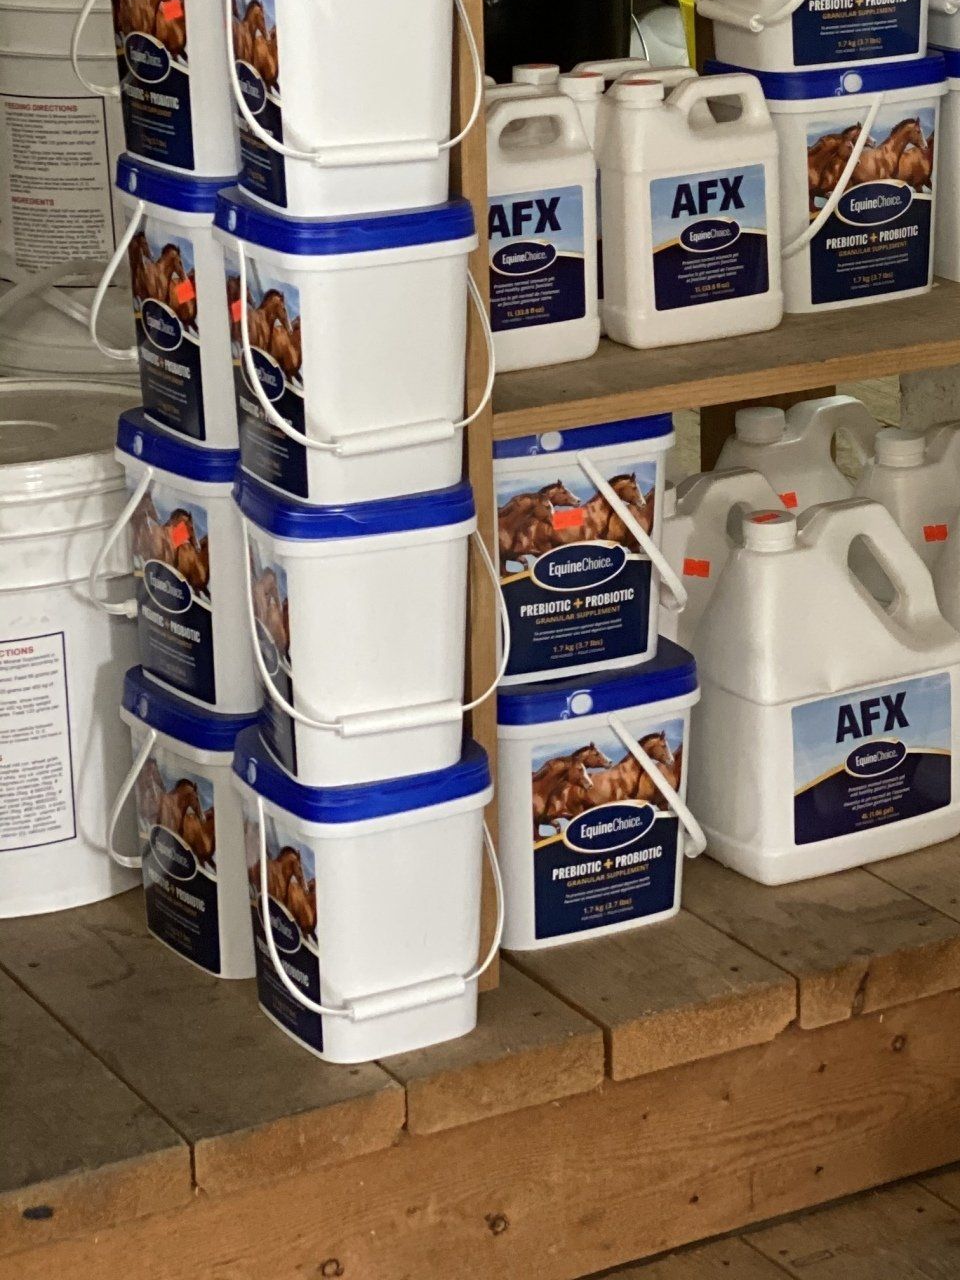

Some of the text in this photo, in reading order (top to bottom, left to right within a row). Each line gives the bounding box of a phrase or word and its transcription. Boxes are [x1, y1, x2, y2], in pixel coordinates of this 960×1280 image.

[32, 102, 78, 113] DIRECTIONS
[671, 174, 746, 220] AFX
[488, 196, 562, 240] AFX
[826, 235, 868, 250] PREBIOTIC
[878, 225, 918, 242] PROBIOTIC
[520, 598, 572, 618] PREBIOTIC
[585, 588, 635, 608] PROBIOTIC
[834, 691, 910, 744] AFX
[552, 862, 602, 880] PREBIOTIC
[615, 846, 662, 867] PROBIOTIC
